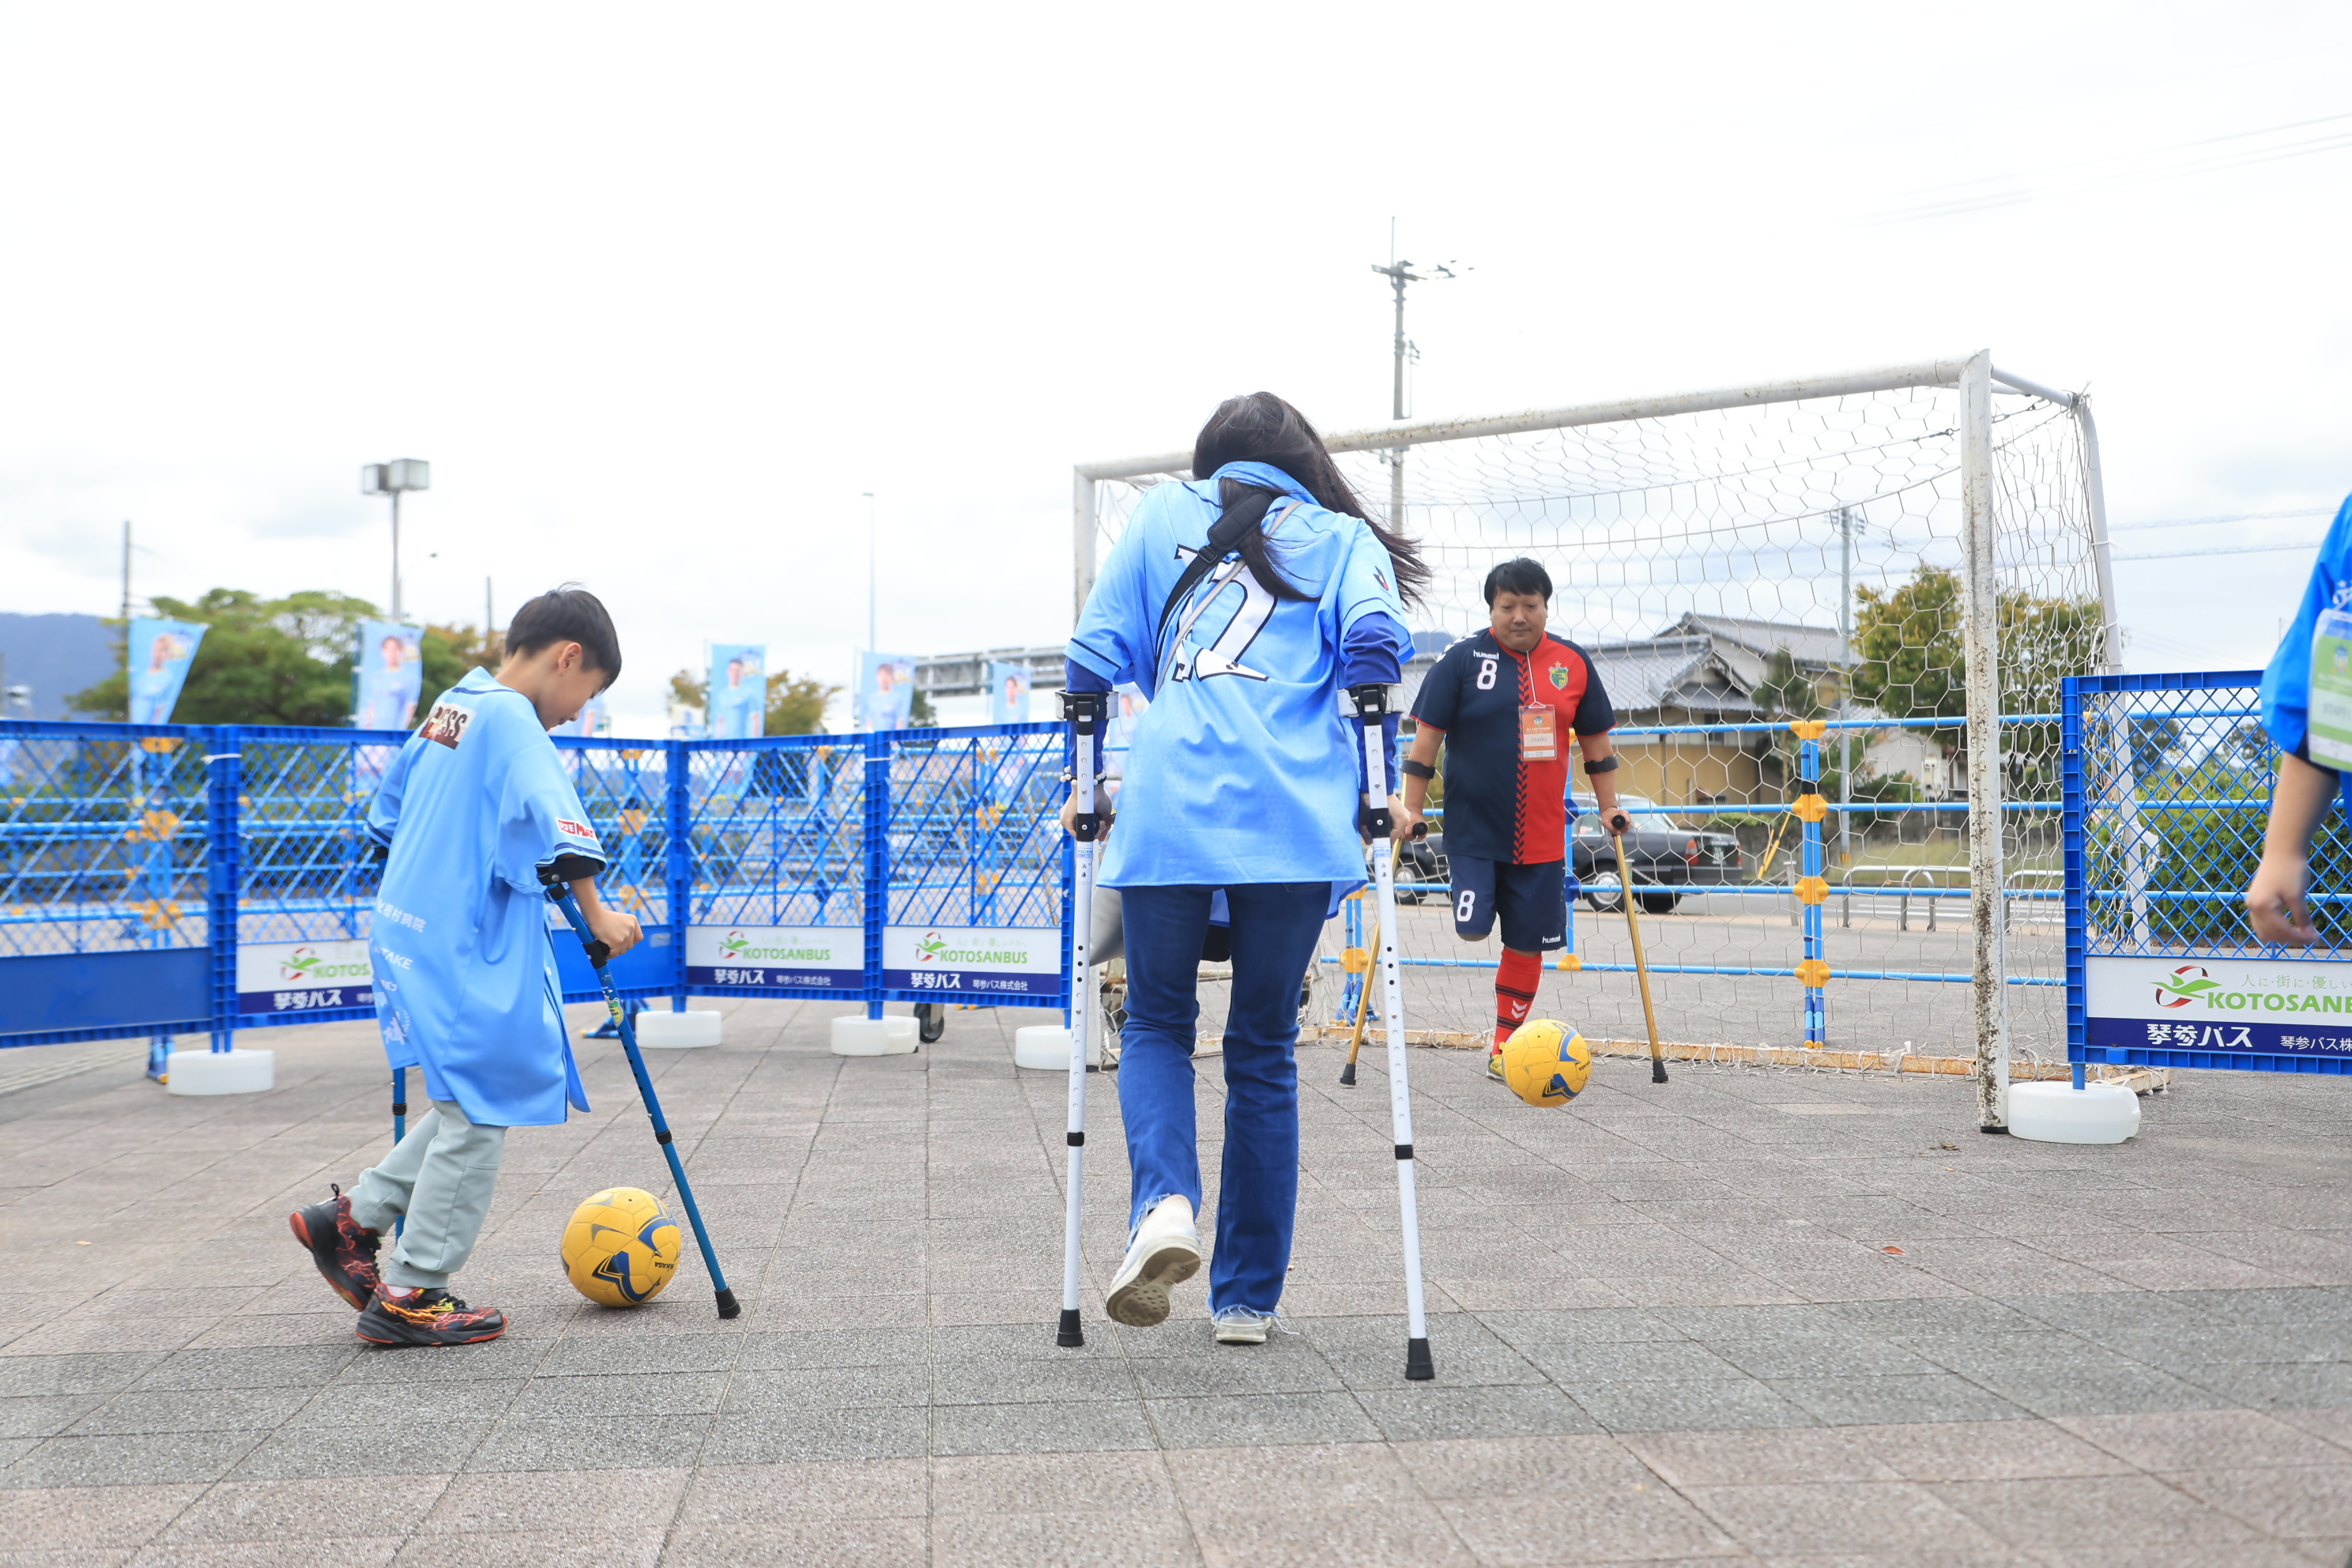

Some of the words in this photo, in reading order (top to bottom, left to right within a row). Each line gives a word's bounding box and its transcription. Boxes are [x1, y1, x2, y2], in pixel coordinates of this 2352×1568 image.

[1472, 650, 1500, 661] hummel
[1476, 658, 1498, 691] 8
[1457, 890, 1476, 922] 8
[743, 948, 831, 961] KOTOSANBUS
[940, 949, 1028, 965] KOTOSANBUS
[714, 968, 765, 985] 琴参バス
[910, 971, 961, 989] 琴参バス
[2147, 1023, 2253, 1049] 琴参バス
